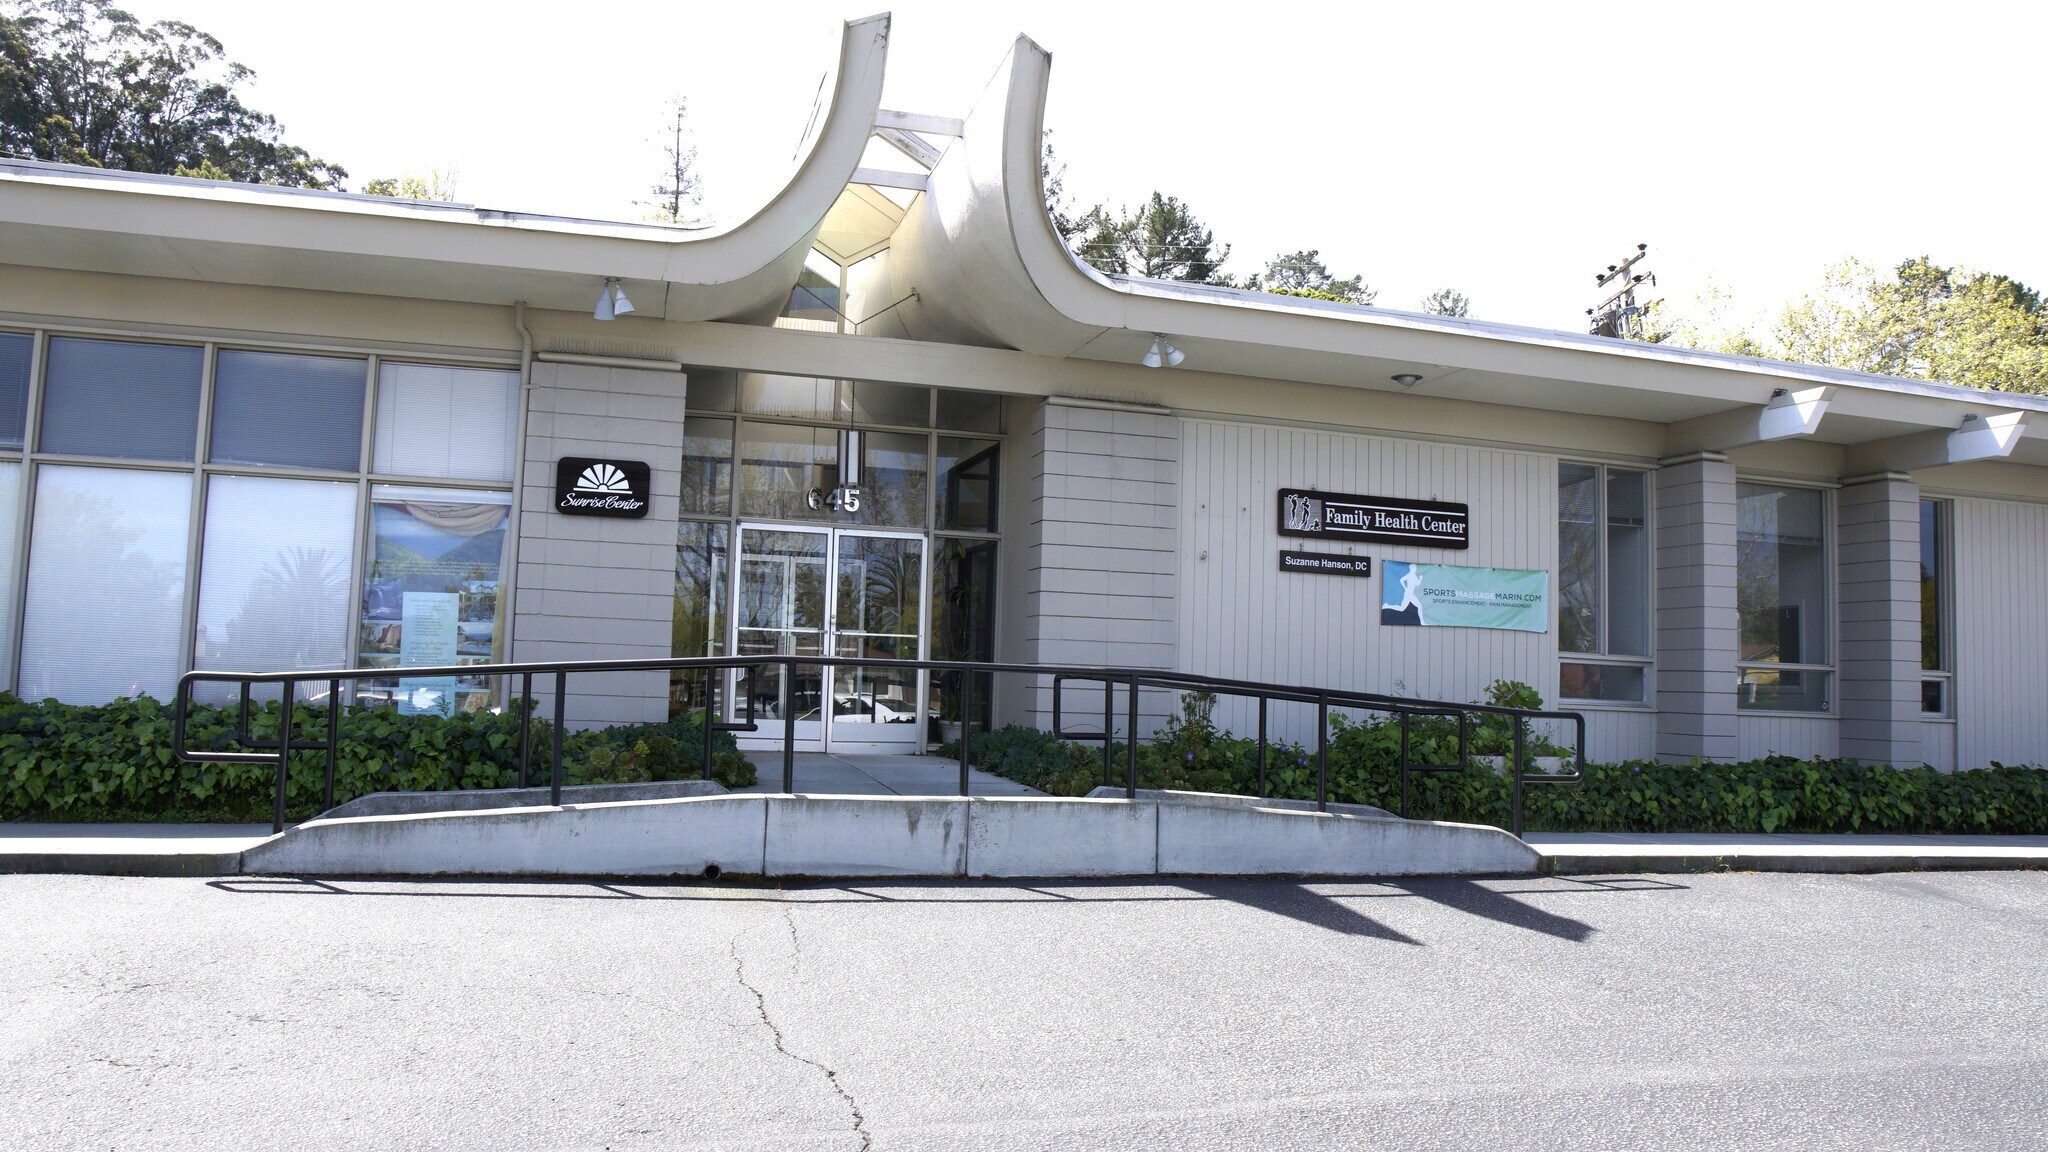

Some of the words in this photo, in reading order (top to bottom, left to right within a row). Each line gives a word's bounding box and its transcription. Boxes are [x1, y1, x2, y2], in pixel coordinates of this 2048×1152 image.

[561, 492, 606, 508] Sunrise
[605, 495, 644, 510] Center
[807, 487, 860, 512] 645
[1325, 507, 1371, 530] Family
[1374, 511, 1419, 530] Health
[1421, 515, 1466, 534] Center
[1285, 556, 1320, 567] Suzanne
[1321, 559, 1354, 571] Hanson,
[1355, 561, 1368, 571] DC
